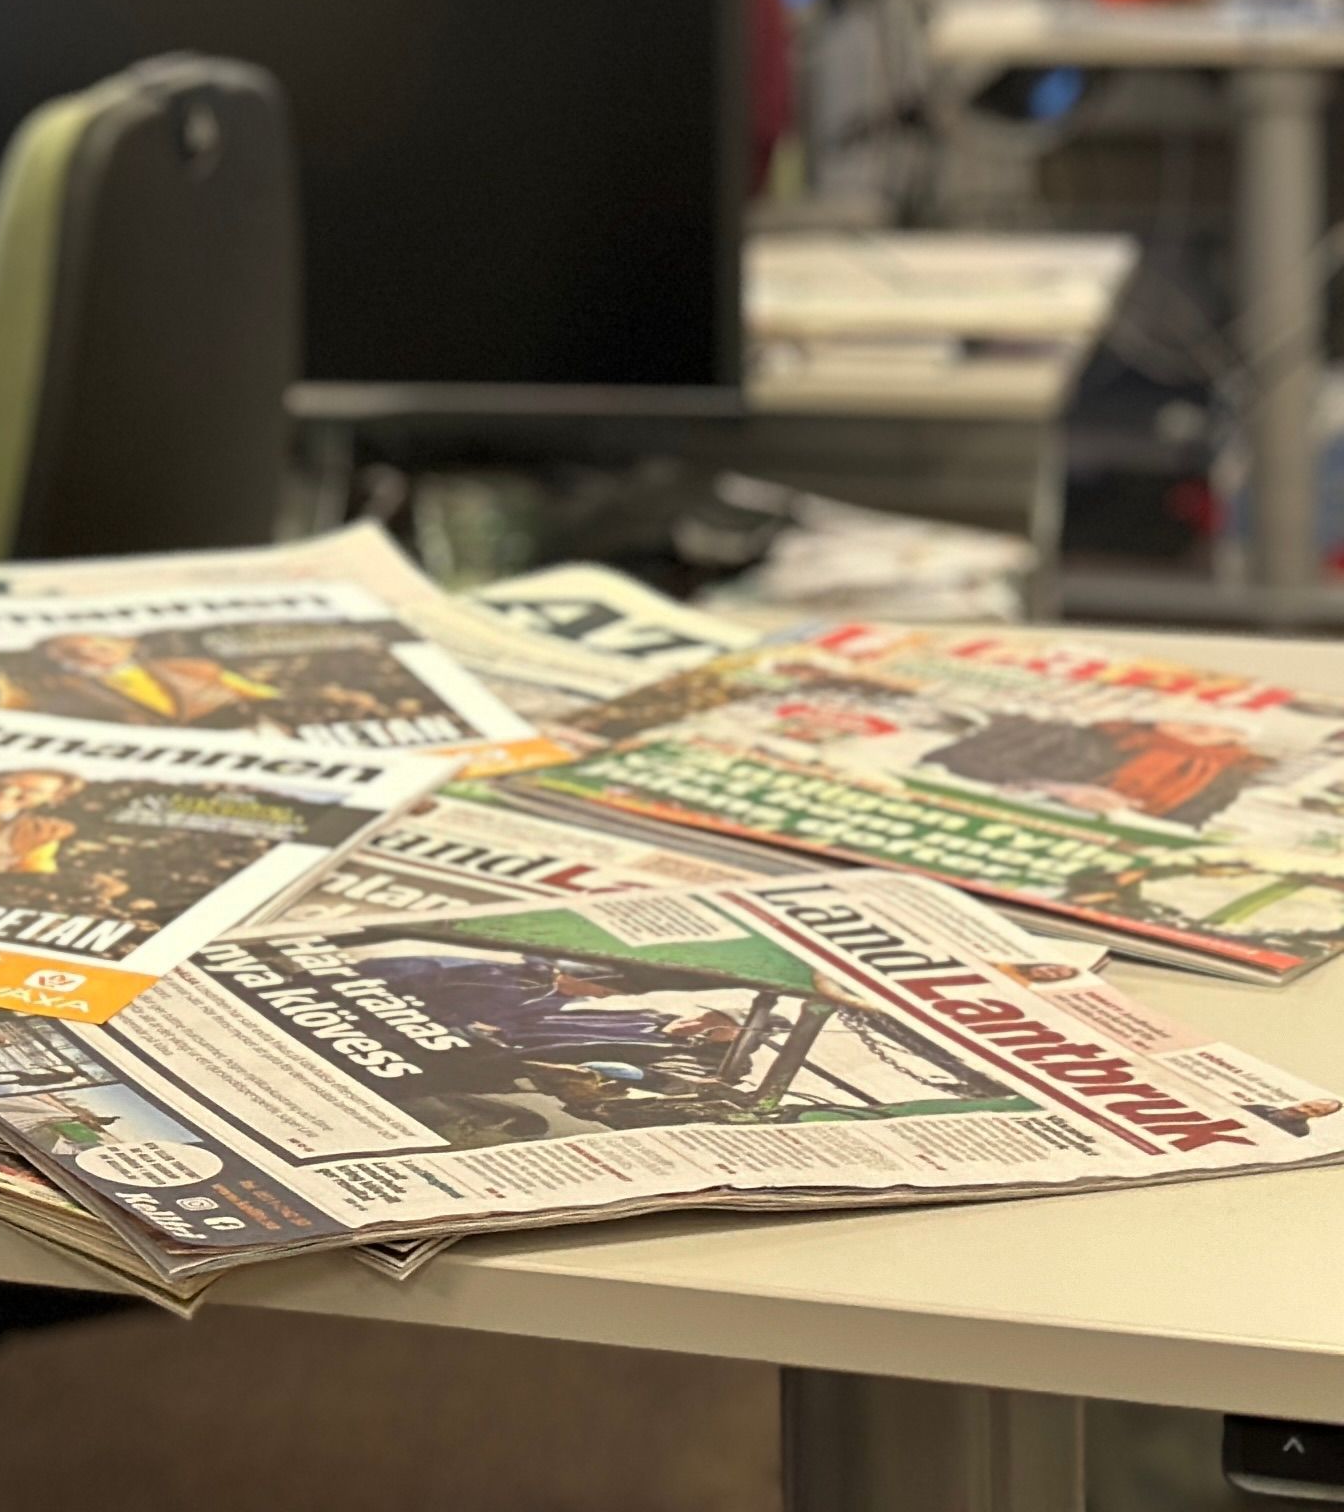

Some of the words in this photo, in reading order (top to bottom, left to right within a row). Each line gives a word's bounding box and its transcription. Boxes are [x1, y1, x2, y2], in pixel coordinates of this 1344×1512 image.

[478, 598, 736, 656] AT
[197, 943, 285, 988] nya
[258, 987, 423, 1079] klövess
[266, 935, 360, 978] Här
[331, 977, 472, 1051] tränas
